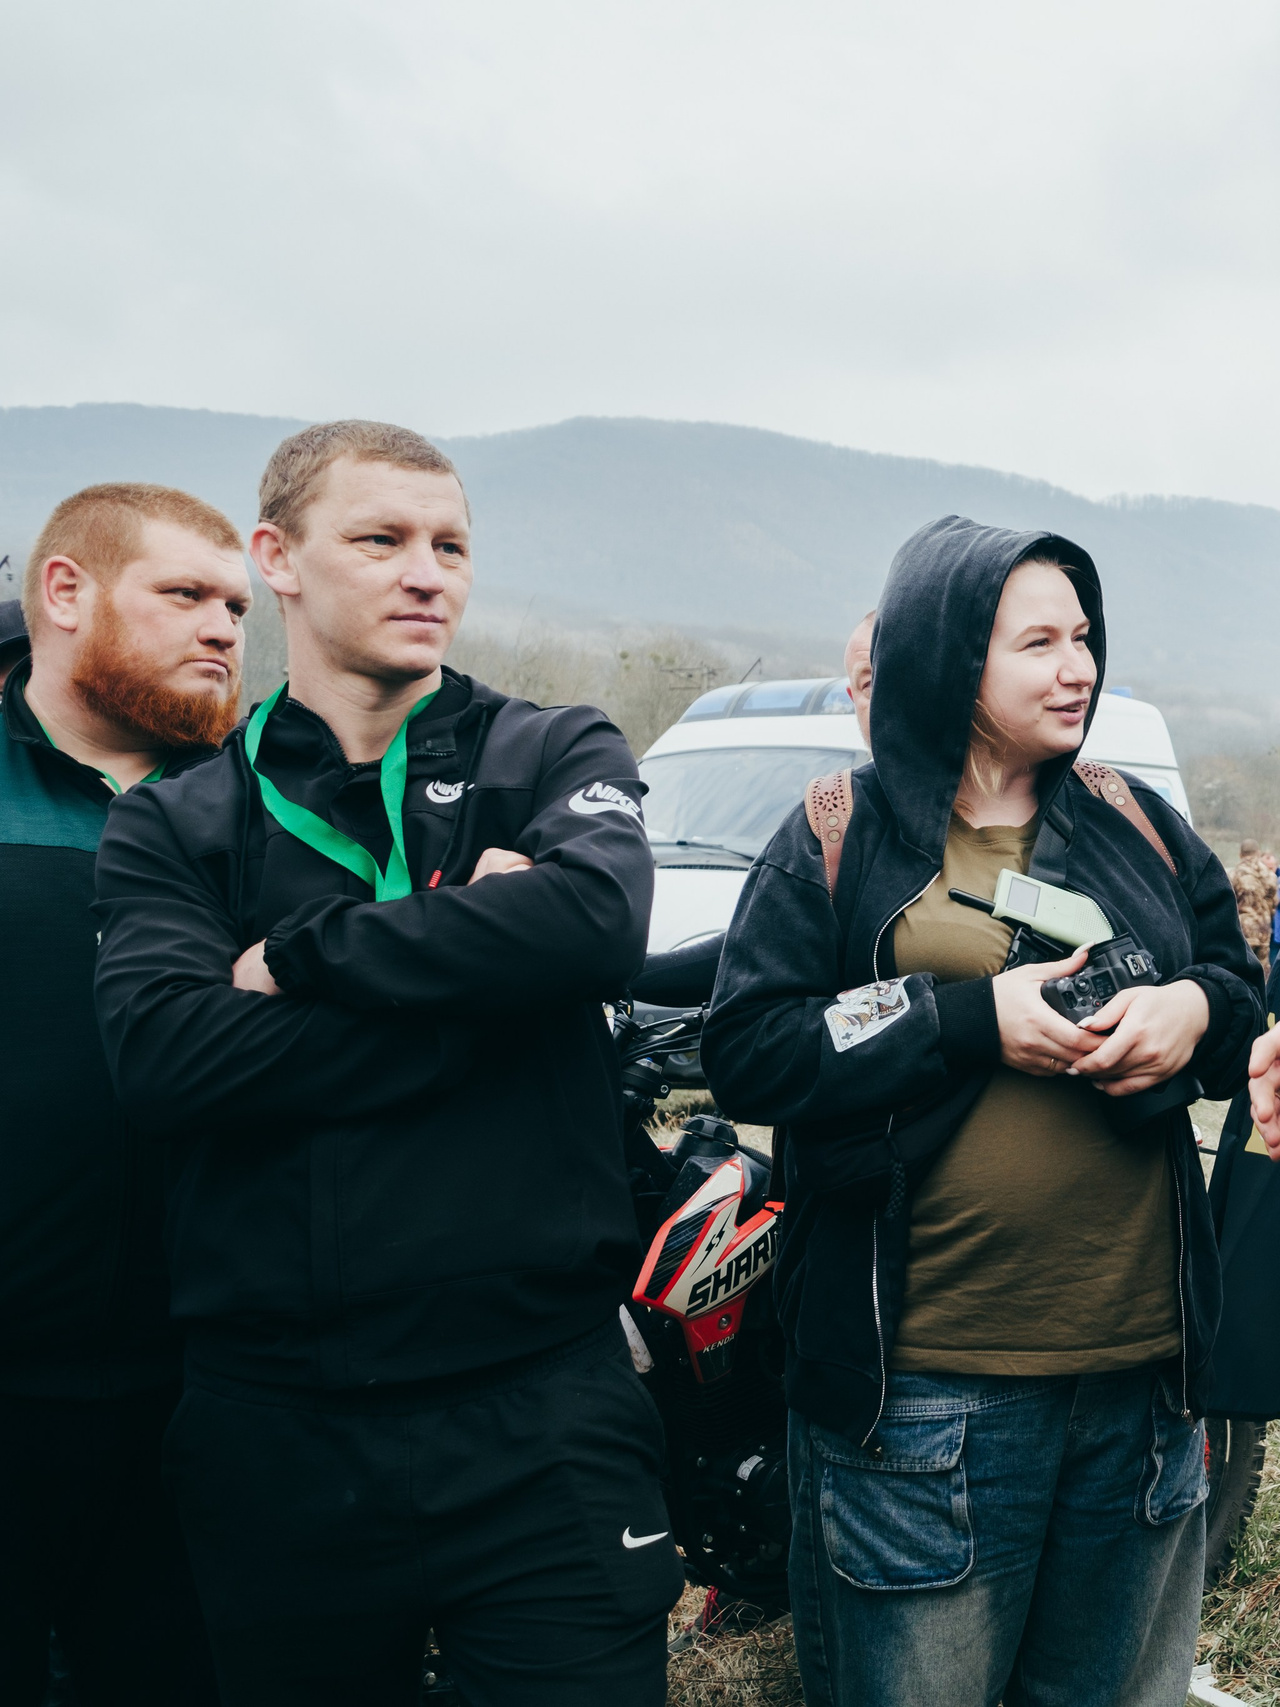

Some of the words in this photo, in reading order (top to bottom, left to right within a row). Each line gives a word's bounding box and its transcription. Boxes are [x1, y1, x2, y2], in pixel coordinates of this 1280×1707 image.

[433, 779, 465, 796] NIKE
[585, 781, 641, 813] NIKE
[703, 1333, 735, 1354] KENDA
